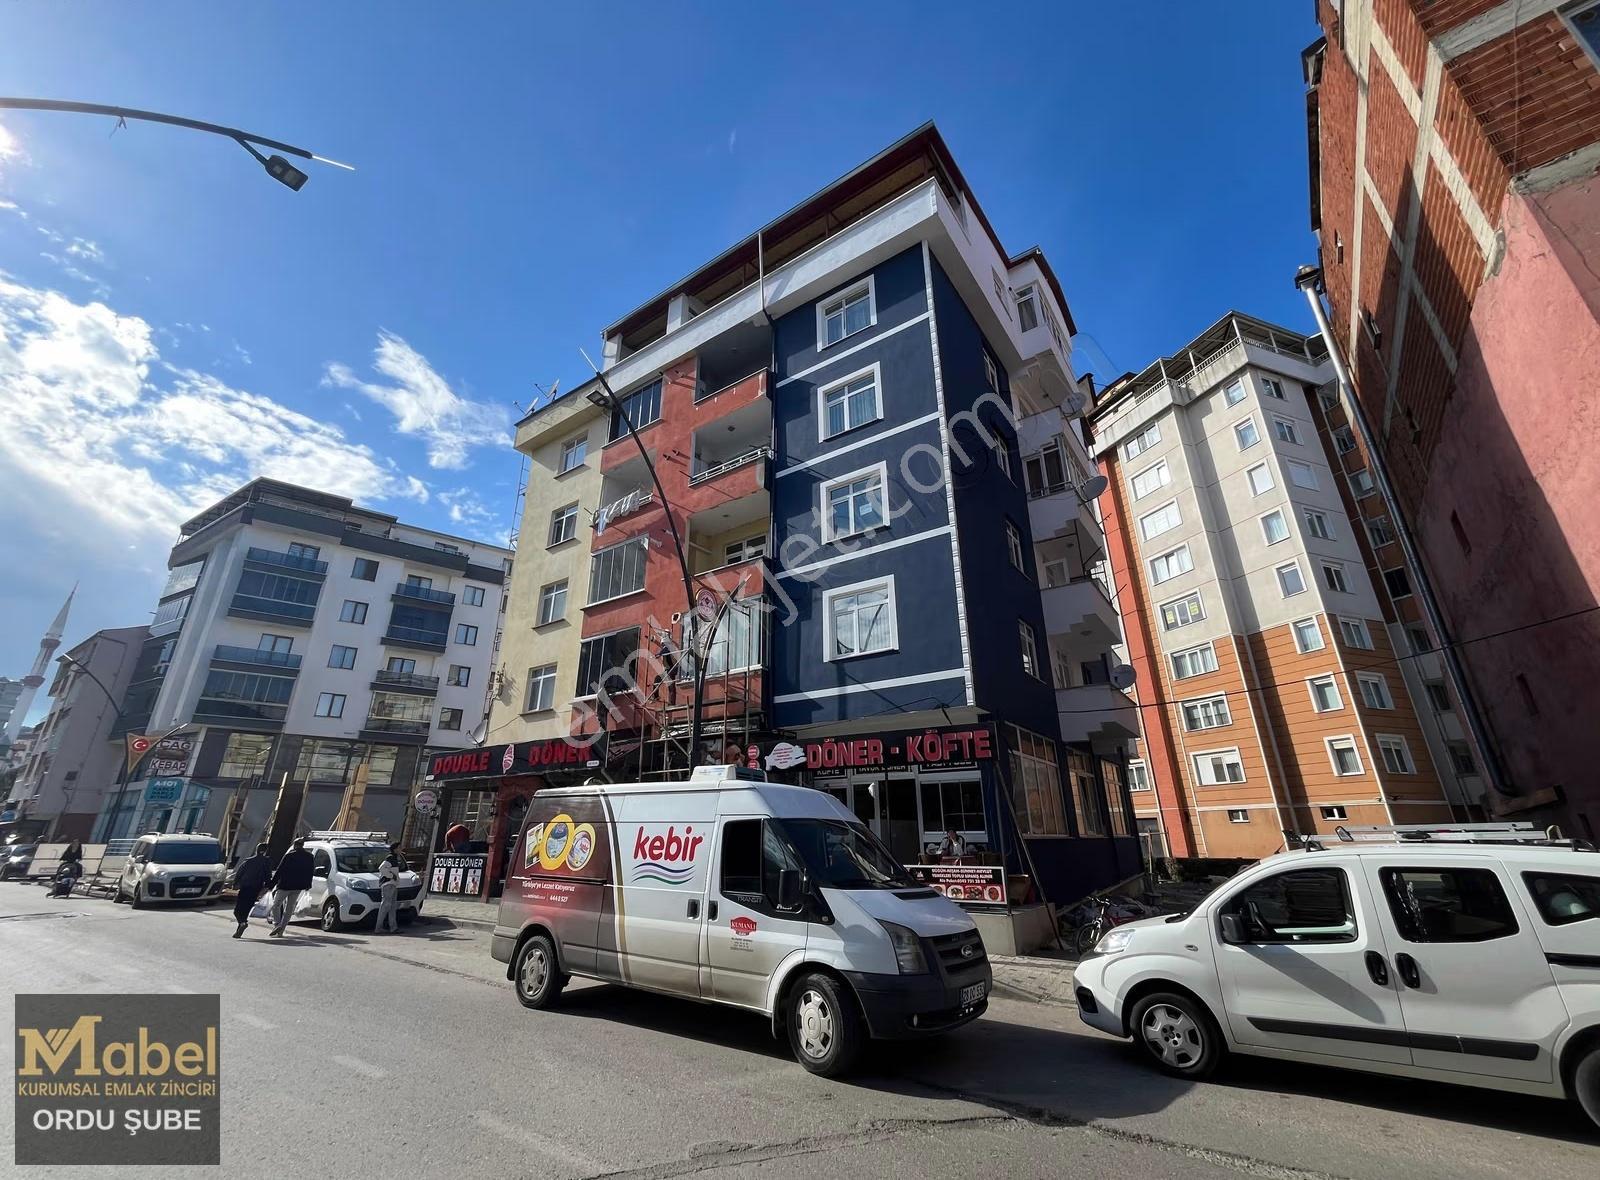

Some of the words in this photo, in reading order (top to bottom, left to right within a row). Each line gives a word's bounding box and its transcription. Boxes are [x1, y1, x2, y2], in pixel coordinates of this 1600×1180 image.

[433, 752, 490, 774] DOUBLE
[528, 742, 592, 766] DÖNER
[807, 738, 884, 768] DÖNER
[906, 729, 992, 762] KÖFTE
[151, 760, 187, 770] KEBAP
[633, 826, 704, 862] kebir
[434, 858, 459, 867] DOUBLE
[460, 858, 483, 868] DÖNER
